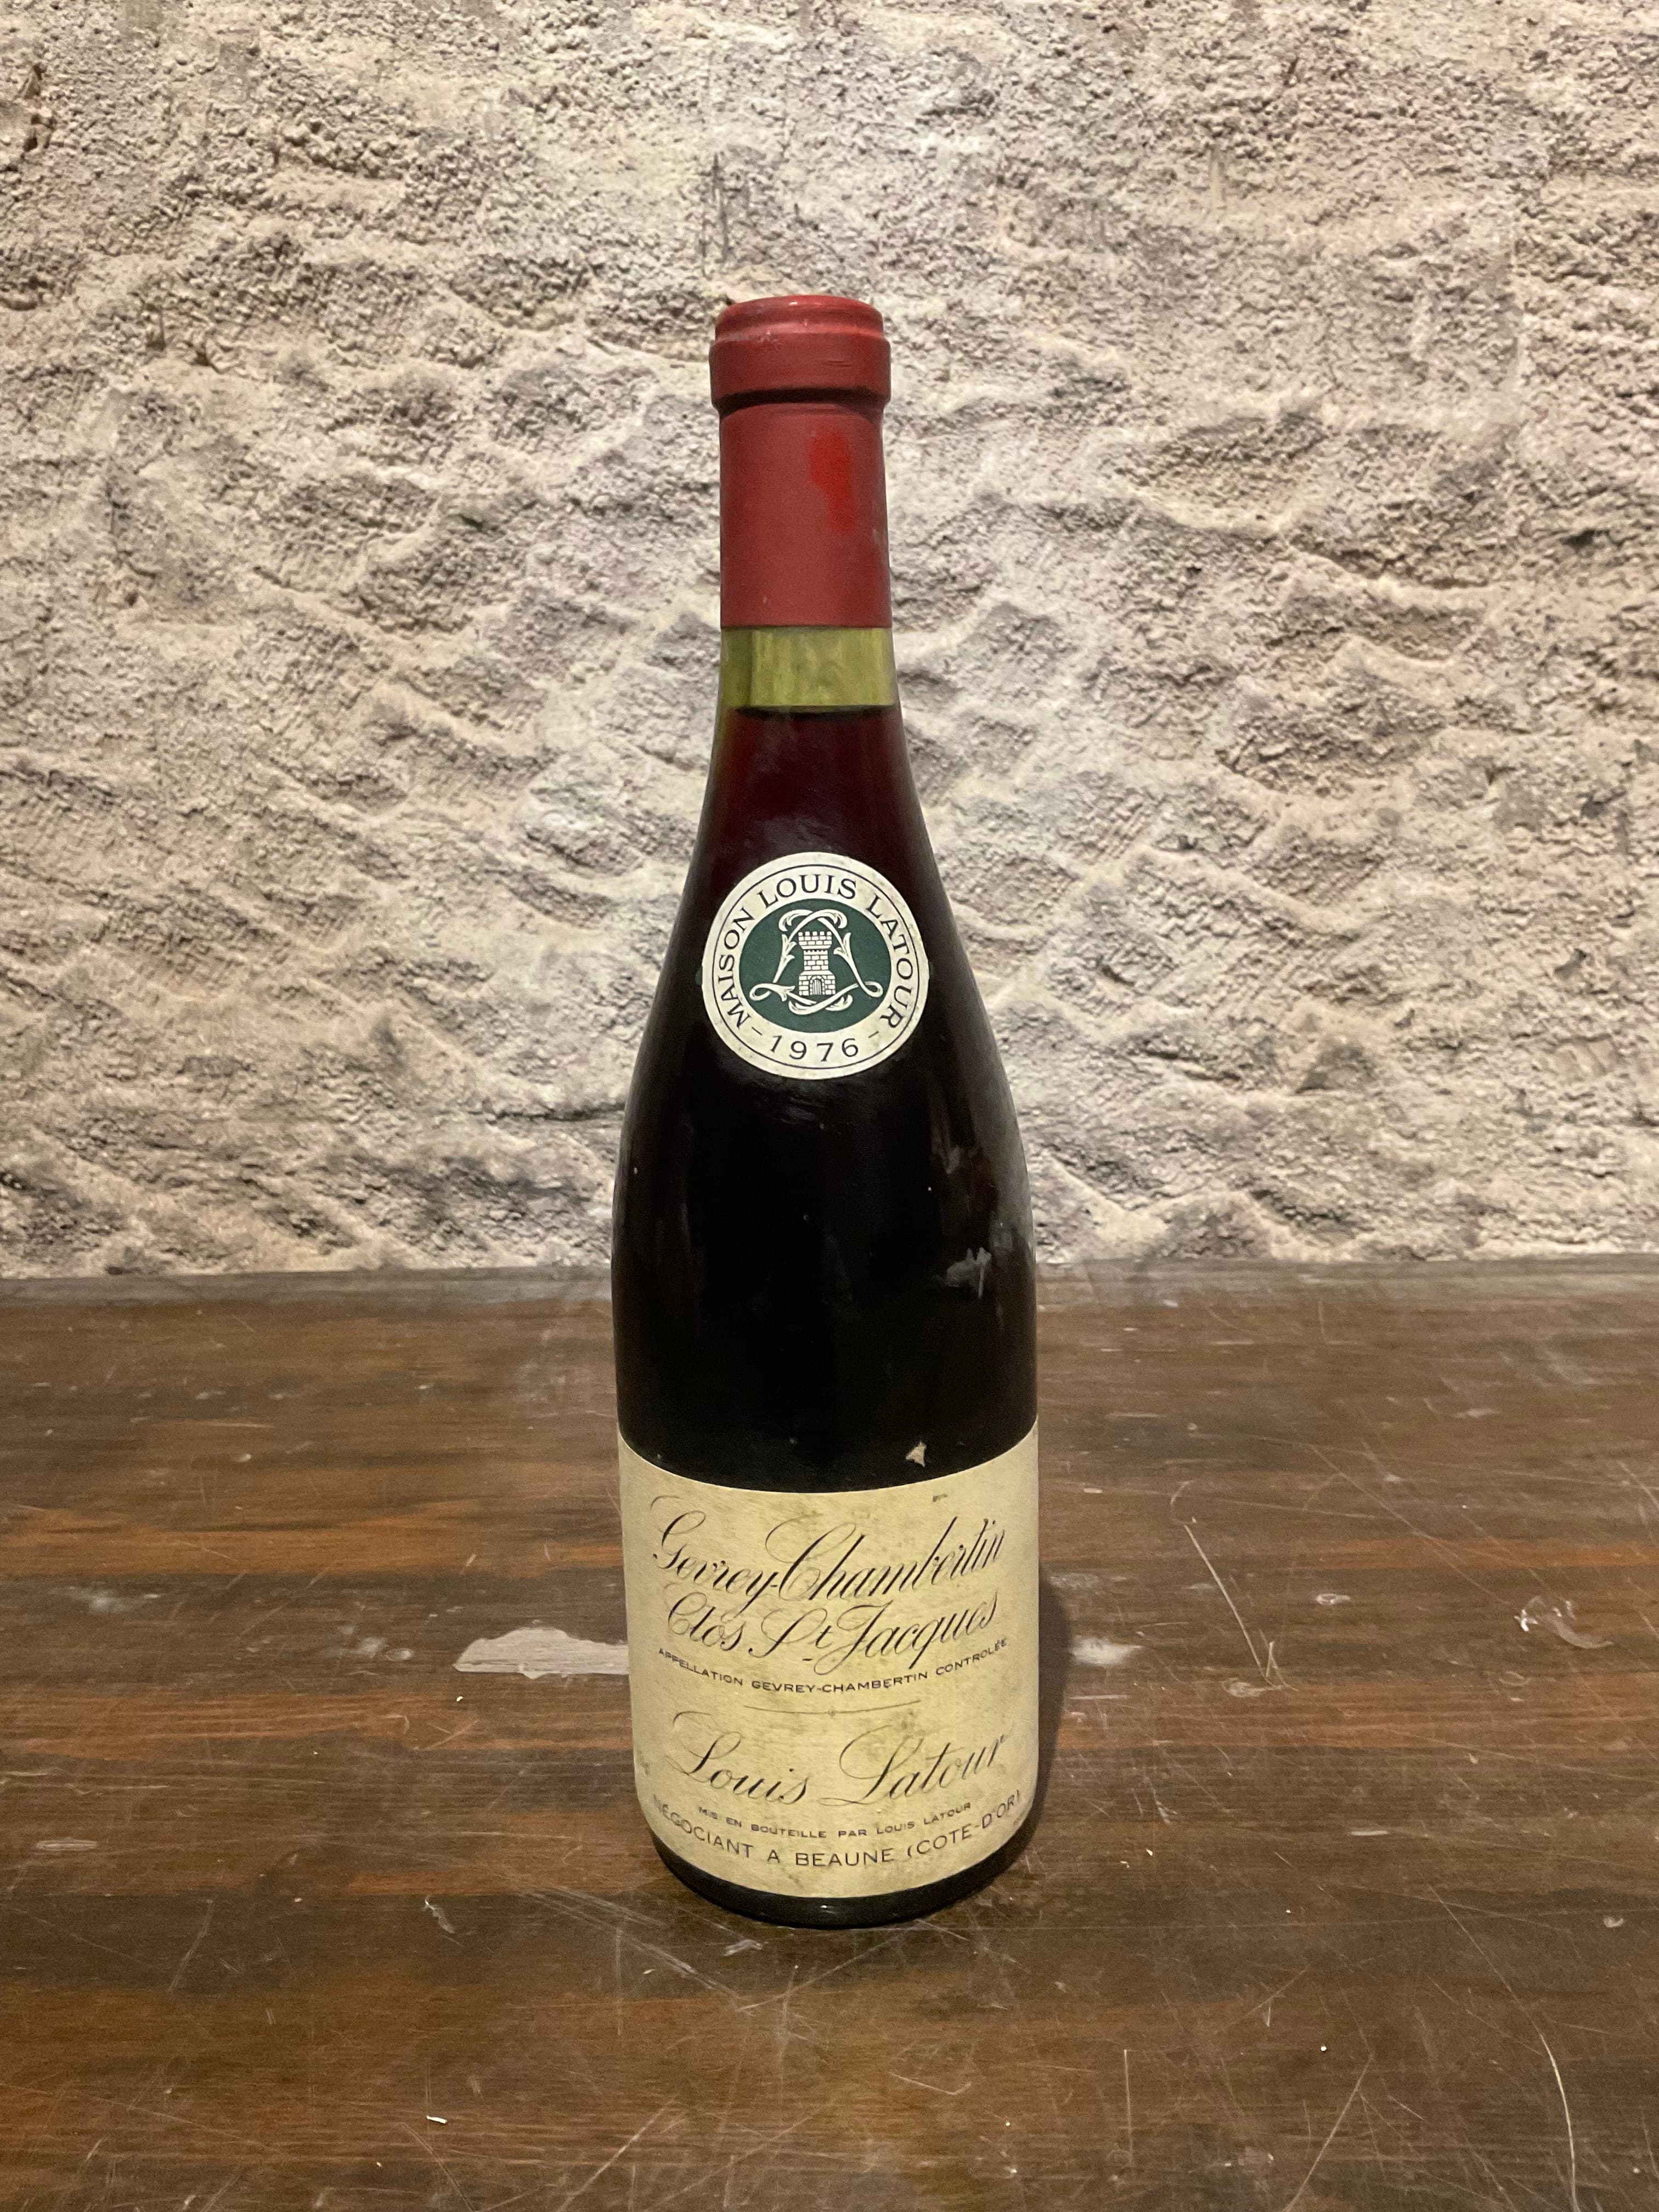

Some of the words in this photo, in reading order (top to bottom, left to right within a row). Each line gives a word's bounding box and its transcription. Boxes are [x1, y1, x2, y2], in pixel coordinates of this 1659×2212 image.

[718, 907, 756, 1030] MAISON
[757, 873, 857, 910] LOUIS
[865, 895, 914, 1030] LATOUR
[769, 1035, 859, 1062] 1976
[662, 1582, 747, 1652] Clos
[814, 1588, 998, 1675] Jacques
[658, 1647, 743, 1686] APPELLATION
[751, 1671, 928, 1694] GEVREY-CHAMBERTIN
[665, 1710, 812, 1805] Louis
[817, 1724, 1015, 1806] Latour
[698, 1806, 718, 1820] MIS
[726, 1816, 742, 1827] EN
[751, 1824, 827, 1839] BOUTEILLE
[838, 1829, 867, 1838] PAR
[877, 1821, 915, 1835] LOUIS
[923, 1802, 971, 1826] LATOUR
[766, 1848, 781, 1864] A
[795, 1847, 895, 1867] BEAUNE
